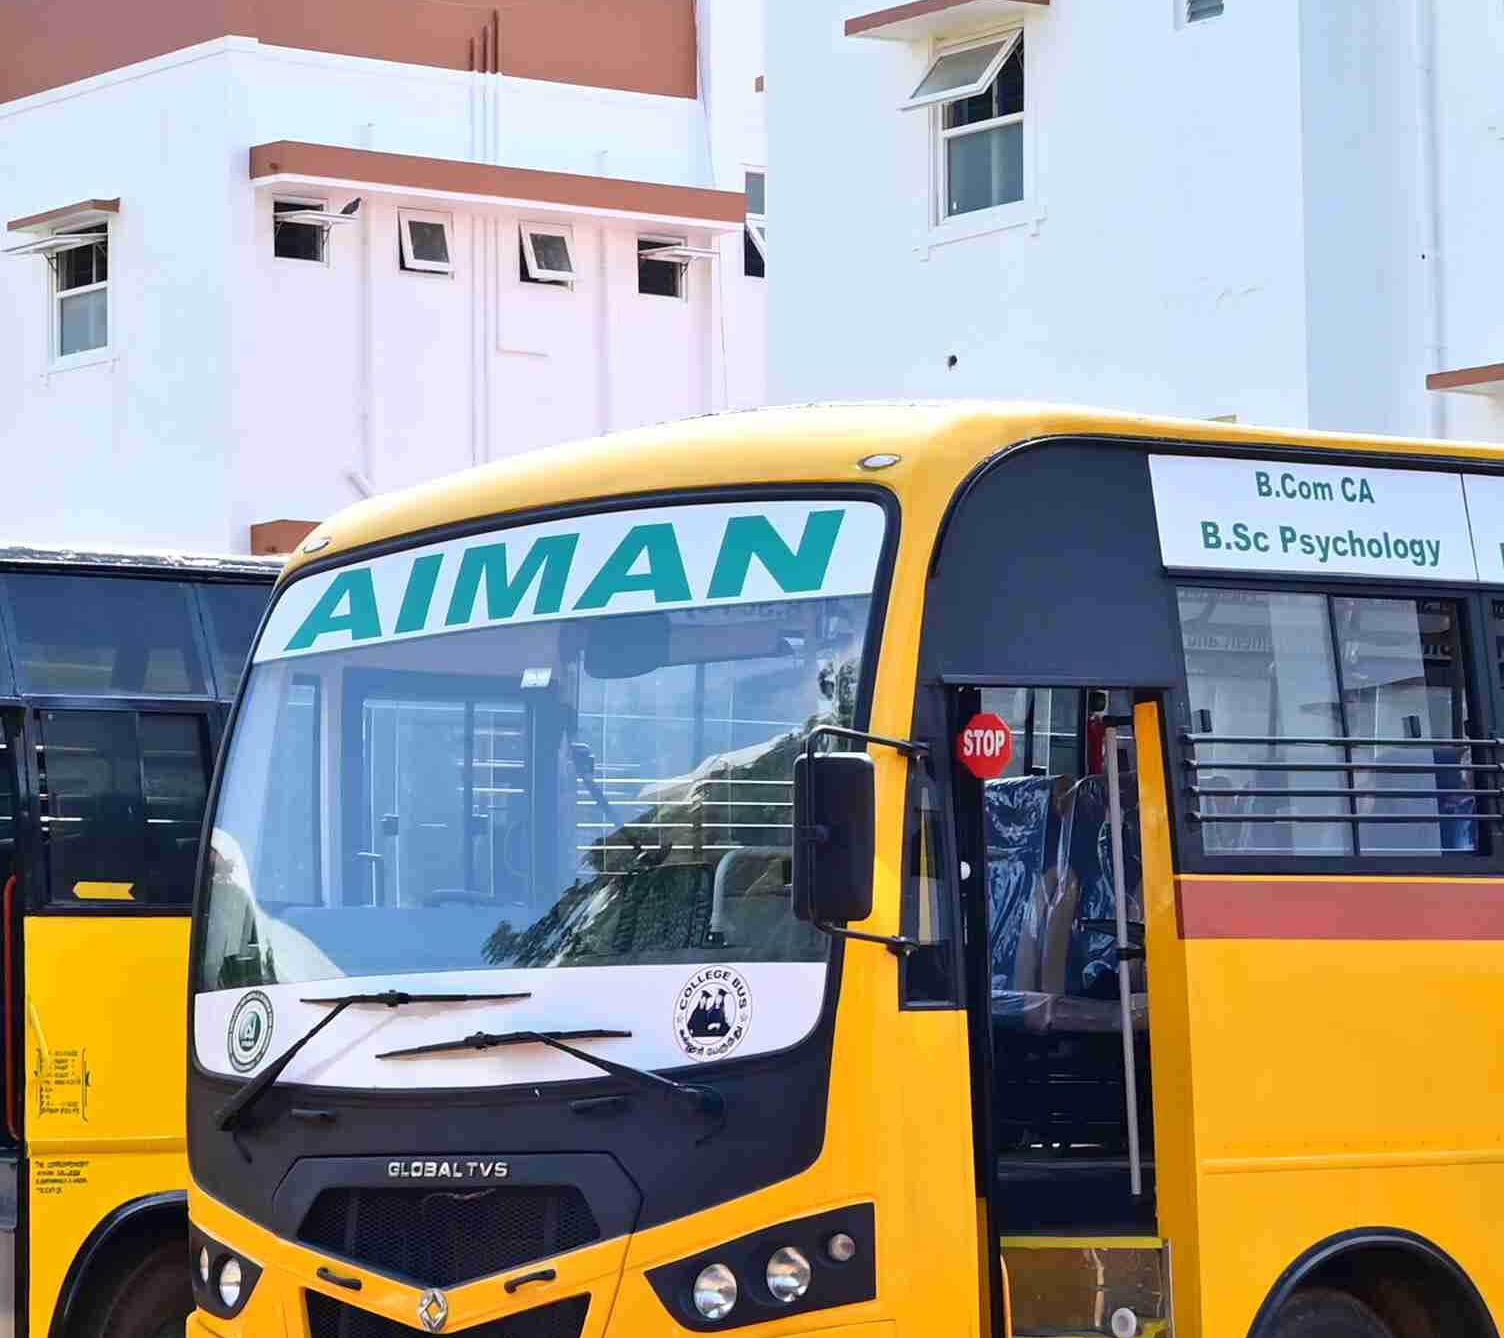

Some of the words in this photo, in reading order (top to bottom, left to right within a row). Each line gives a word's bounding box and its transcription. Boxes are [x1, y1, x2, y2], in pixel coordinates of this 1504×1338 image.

[1255, 470, 1334, 502] B.Com
[1340, 477, 1376, 504] CA
[1200, 520, 1270, 553] B.Sc
[1279, 525, 1441, 567] Psychology
[282, 508, 847, 652] AIMAN
[963, 729, 1007, 758] STOP
[679, 969, 732, 1011] COLLEGE
[731, 977, 748, 1010] BUS
[387, 1161, 464, 1179] GLOBAL
[466, 1161, 510, 1178] TVS
